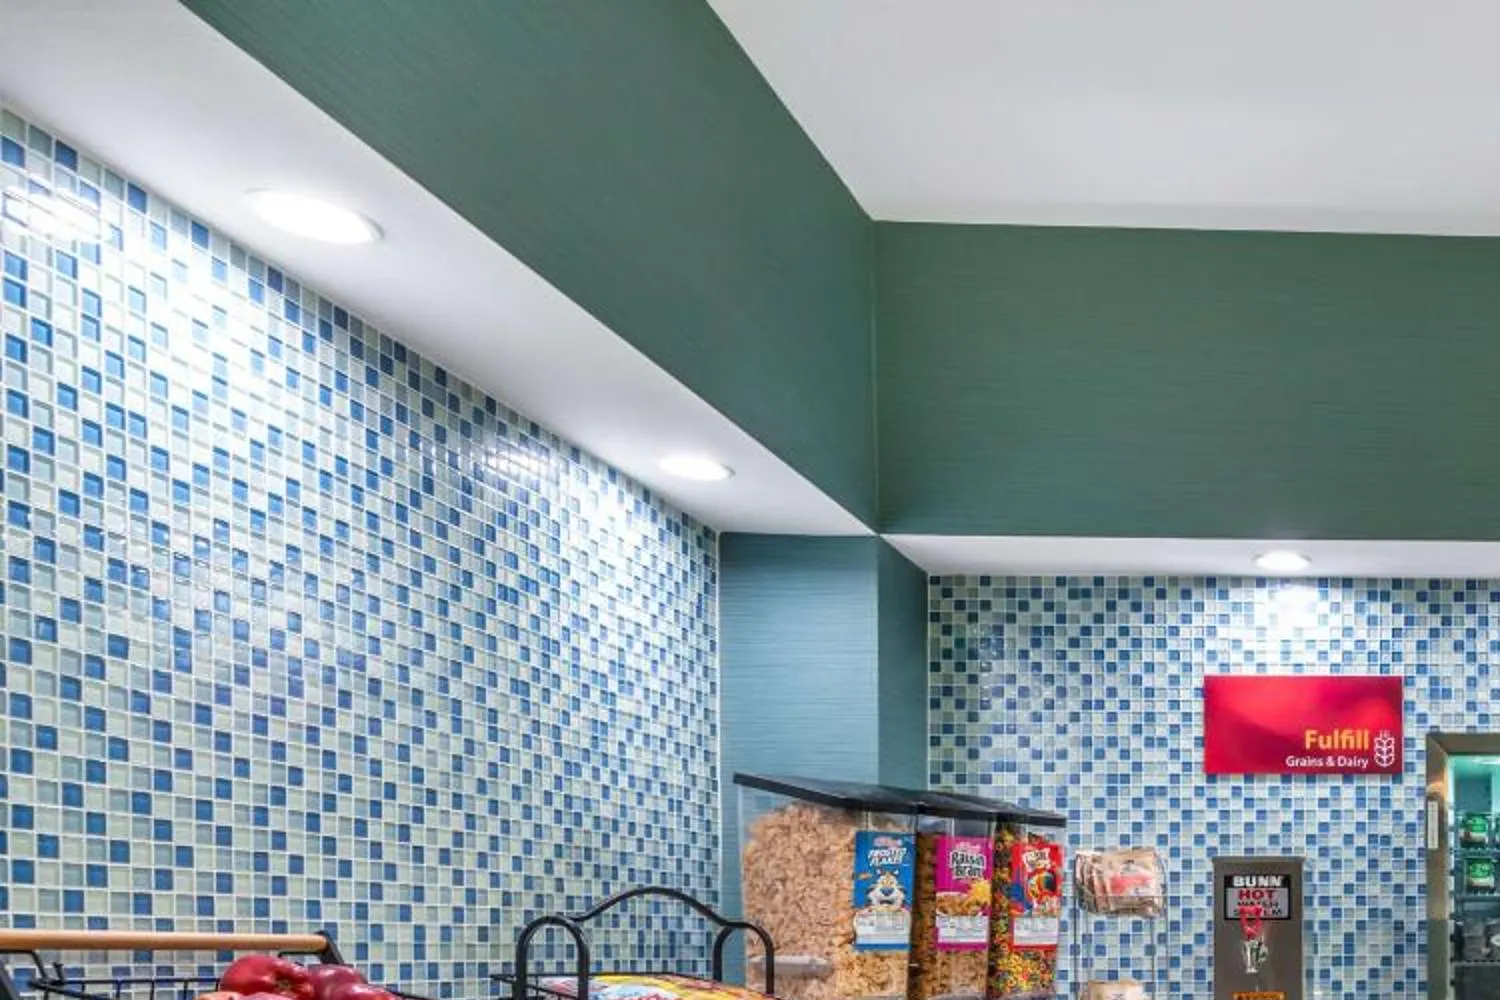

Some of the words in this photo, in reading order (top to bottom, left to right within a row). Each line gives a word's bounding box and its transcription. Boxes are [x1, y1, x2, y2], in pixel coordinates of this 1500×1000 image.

[1304, 728, 1370, 750] Fulfill
[1285, 755, 1324, 768] Grains
[1325, 756, 1335, 768] &
[1337, 756, 1369, 769] Dairy
[951, 851, 986, 867] Raisin
[955, 865, 982, 877] Bran
[1233, 875, 1283, 887] BUNN
[1238, 889, 1275, 900] HOT
